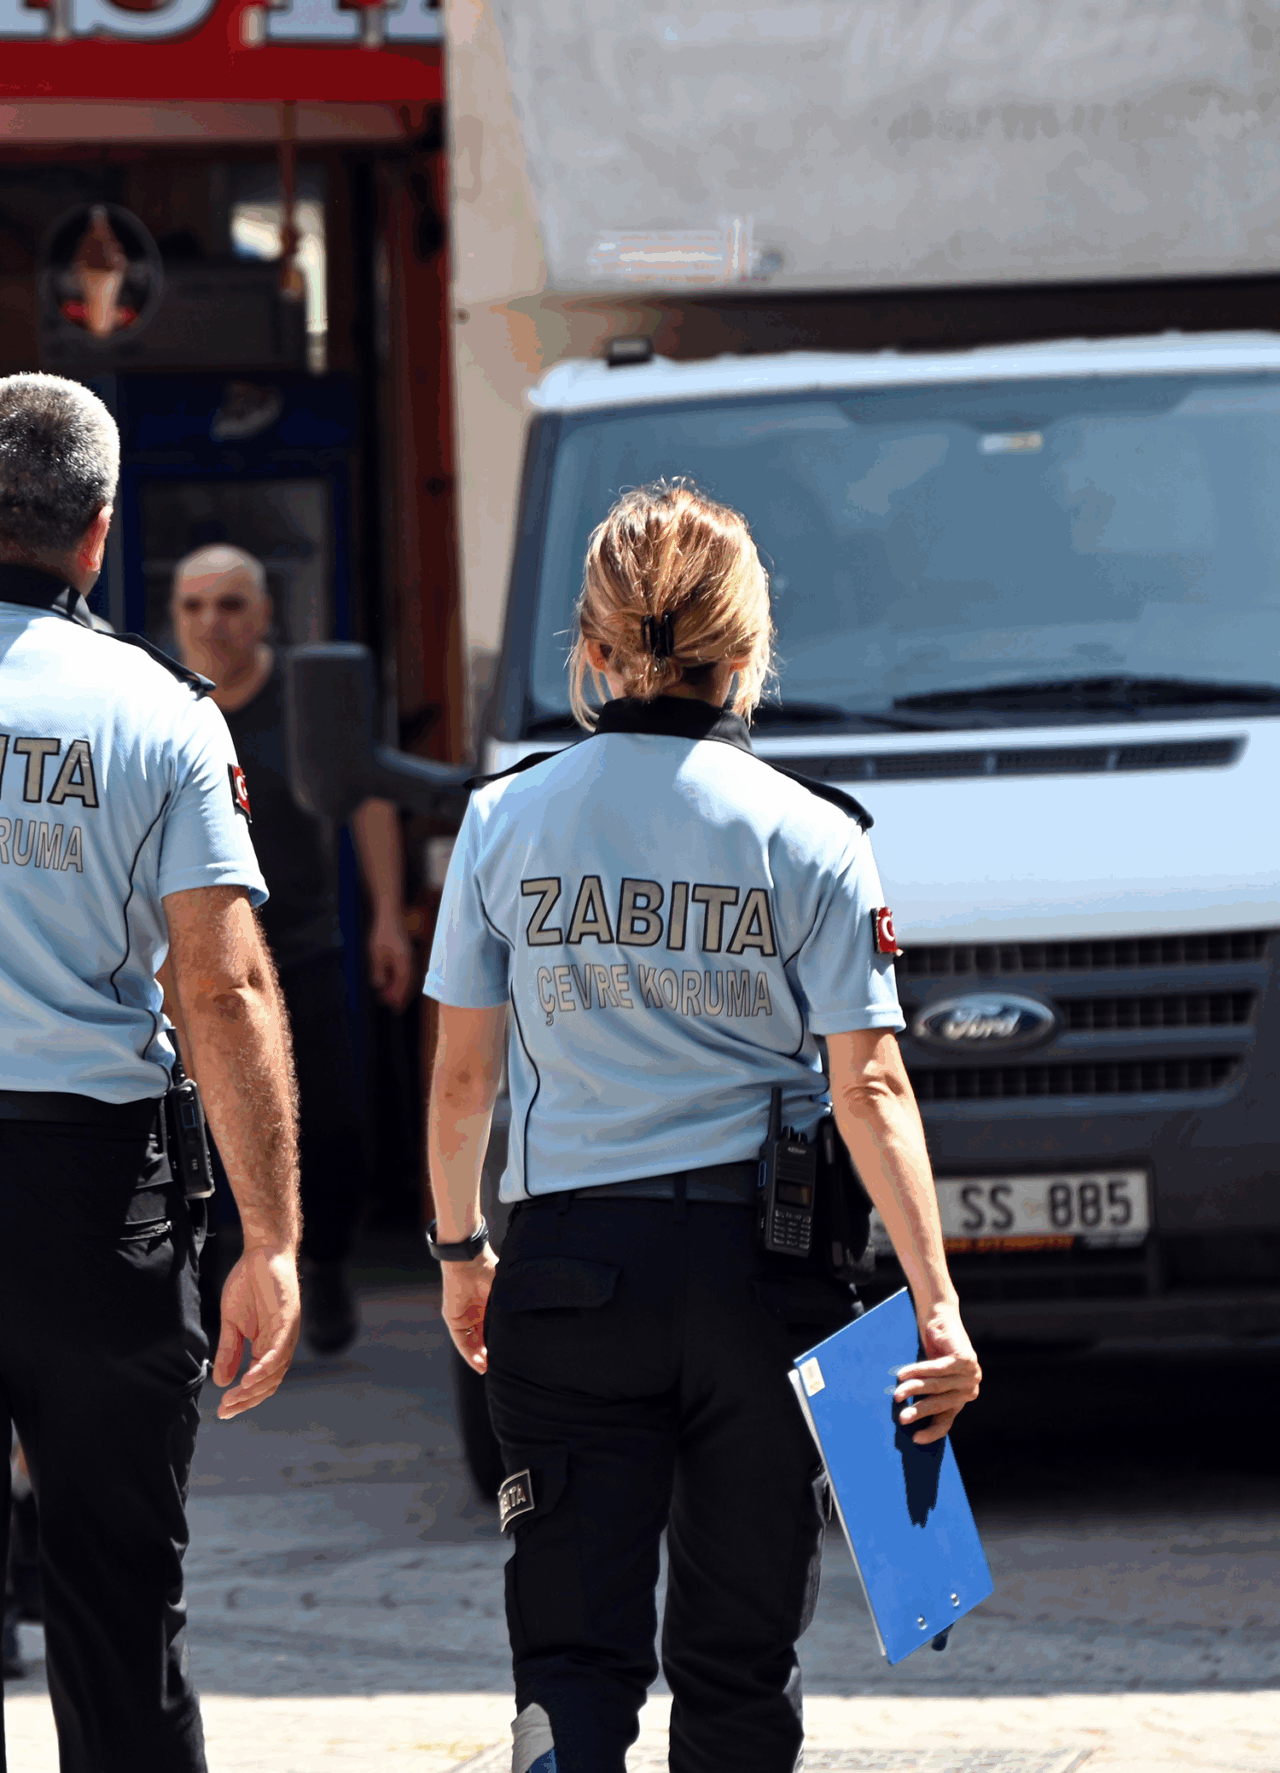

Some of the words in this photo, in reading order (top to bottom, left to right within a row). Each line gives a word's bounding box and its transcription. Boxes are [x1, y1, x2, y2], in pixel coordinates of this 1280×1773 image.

[520, 875, 777, 957] ZABITA
[536, 963, 634, 1026] ÇEVRE
[637, 963, 772, 1018] KORUMA
[961, 1184, 1015, 1231] SS
[1048, 1179, 1133, 1227] 885
